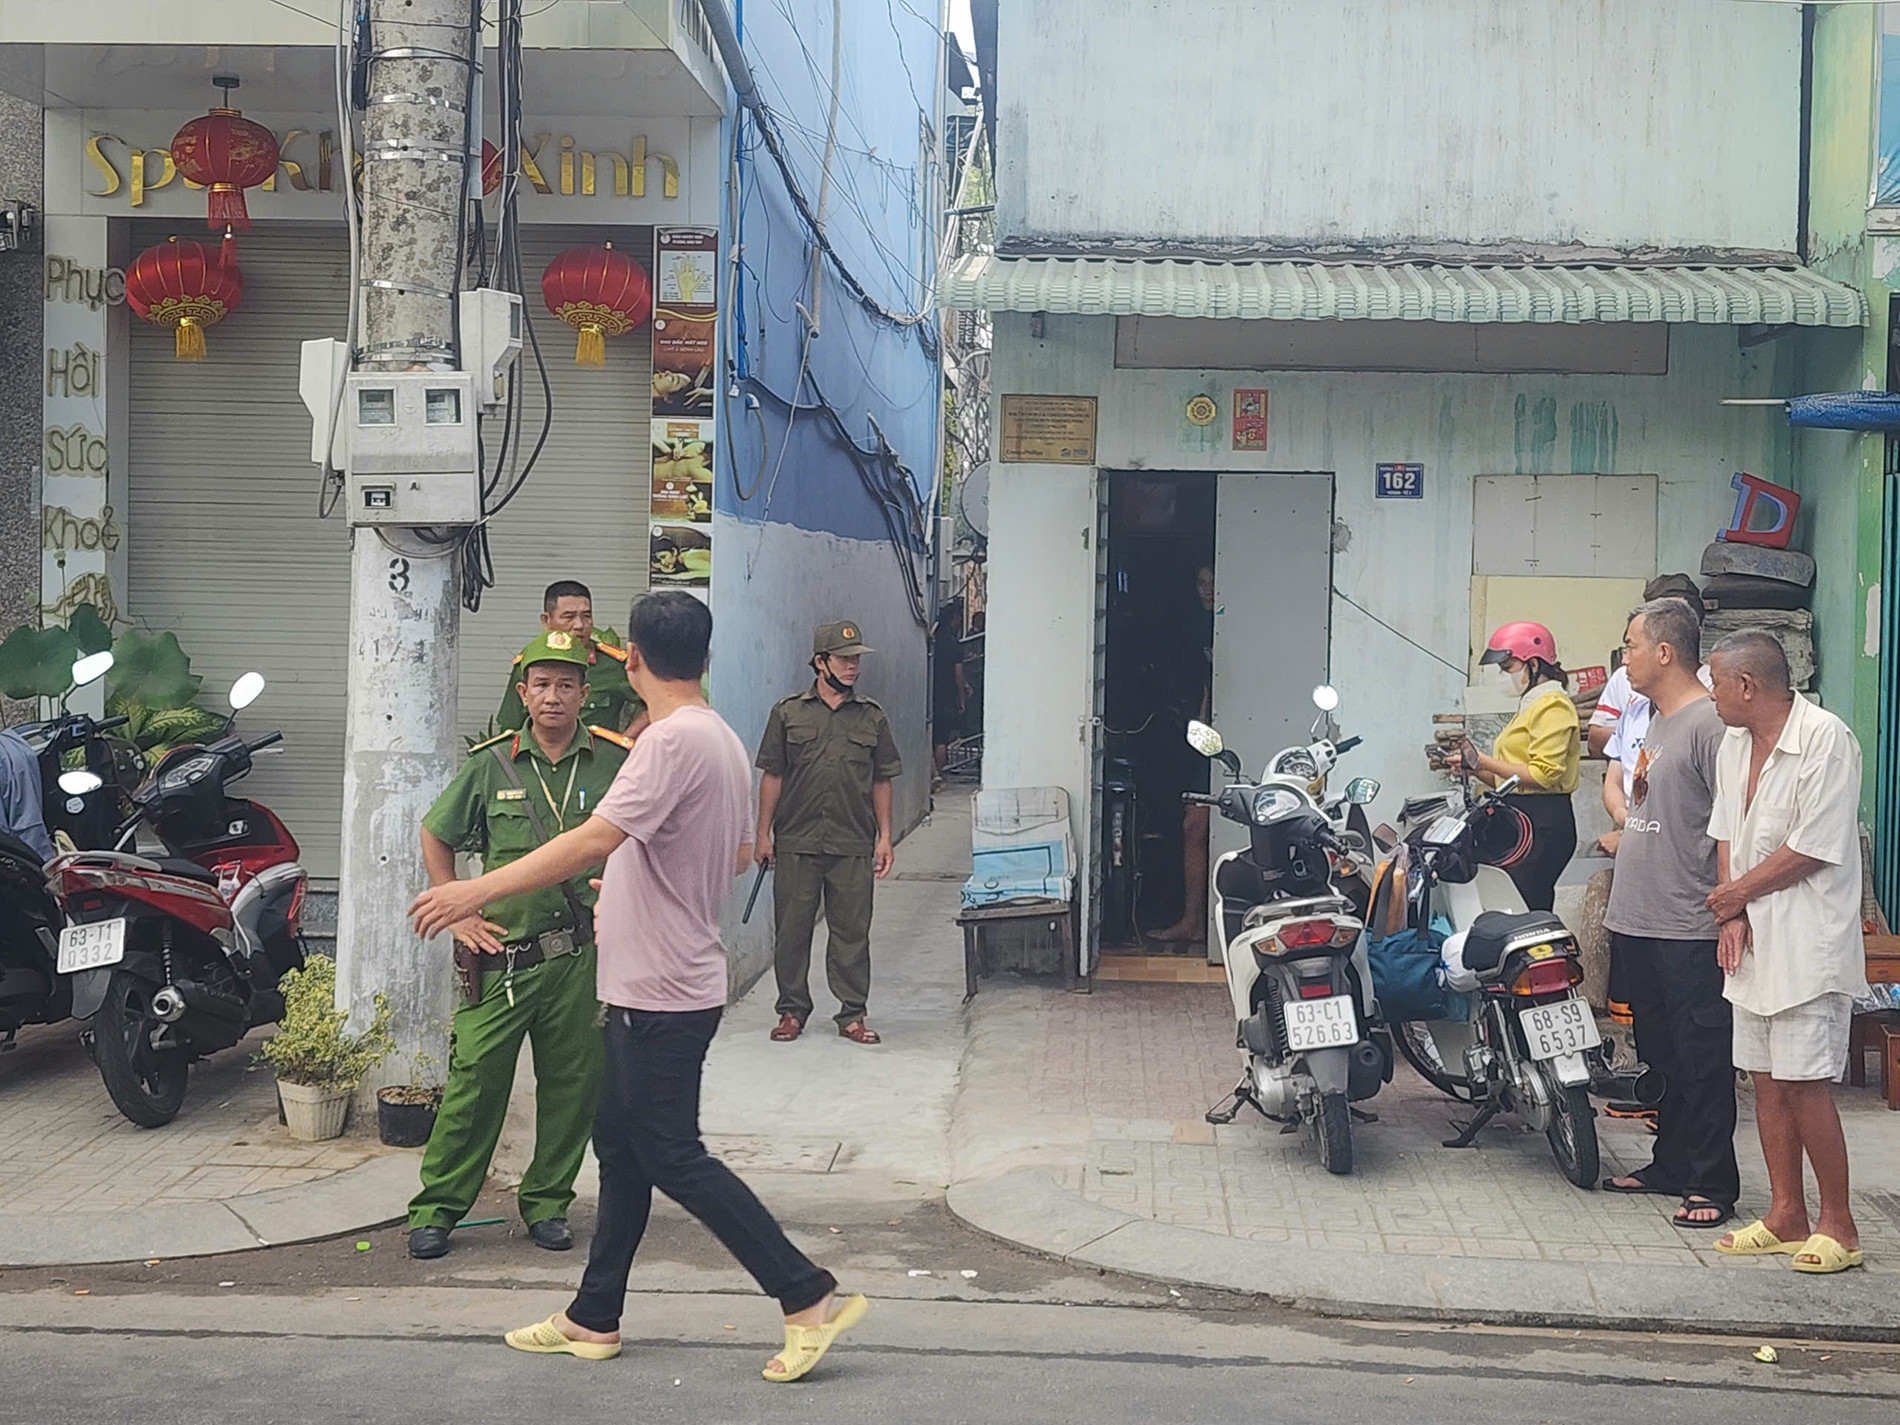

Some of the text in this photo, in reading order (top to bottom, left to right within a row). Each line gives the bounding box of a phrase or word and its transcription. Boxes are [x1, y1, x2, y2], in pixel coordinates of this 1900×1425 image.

[84, 131, 204, 207] Sp
[518, 131, 679, 198] Xinh
[46, 257, 126, 312] Phục
[47, 341, 99, 398] Hồi
[46, 425, 108, 474] Sức
[1383, 472, 1416, 490] 162
[388, 557, 411, 592] 3
[69, 922, 112, 948] 63-T1
[1513, 927, 1551, 941] HONDA
[68, 942, 113, 968] 0332
[1295, 1000, 1342, 1024] 63-C1
[1532, 1003, 1582, 1031] 68-S9
[1292, 1021, 1354, 1046] 526.63
[1539, 1024, 1587, 1054] 6537
